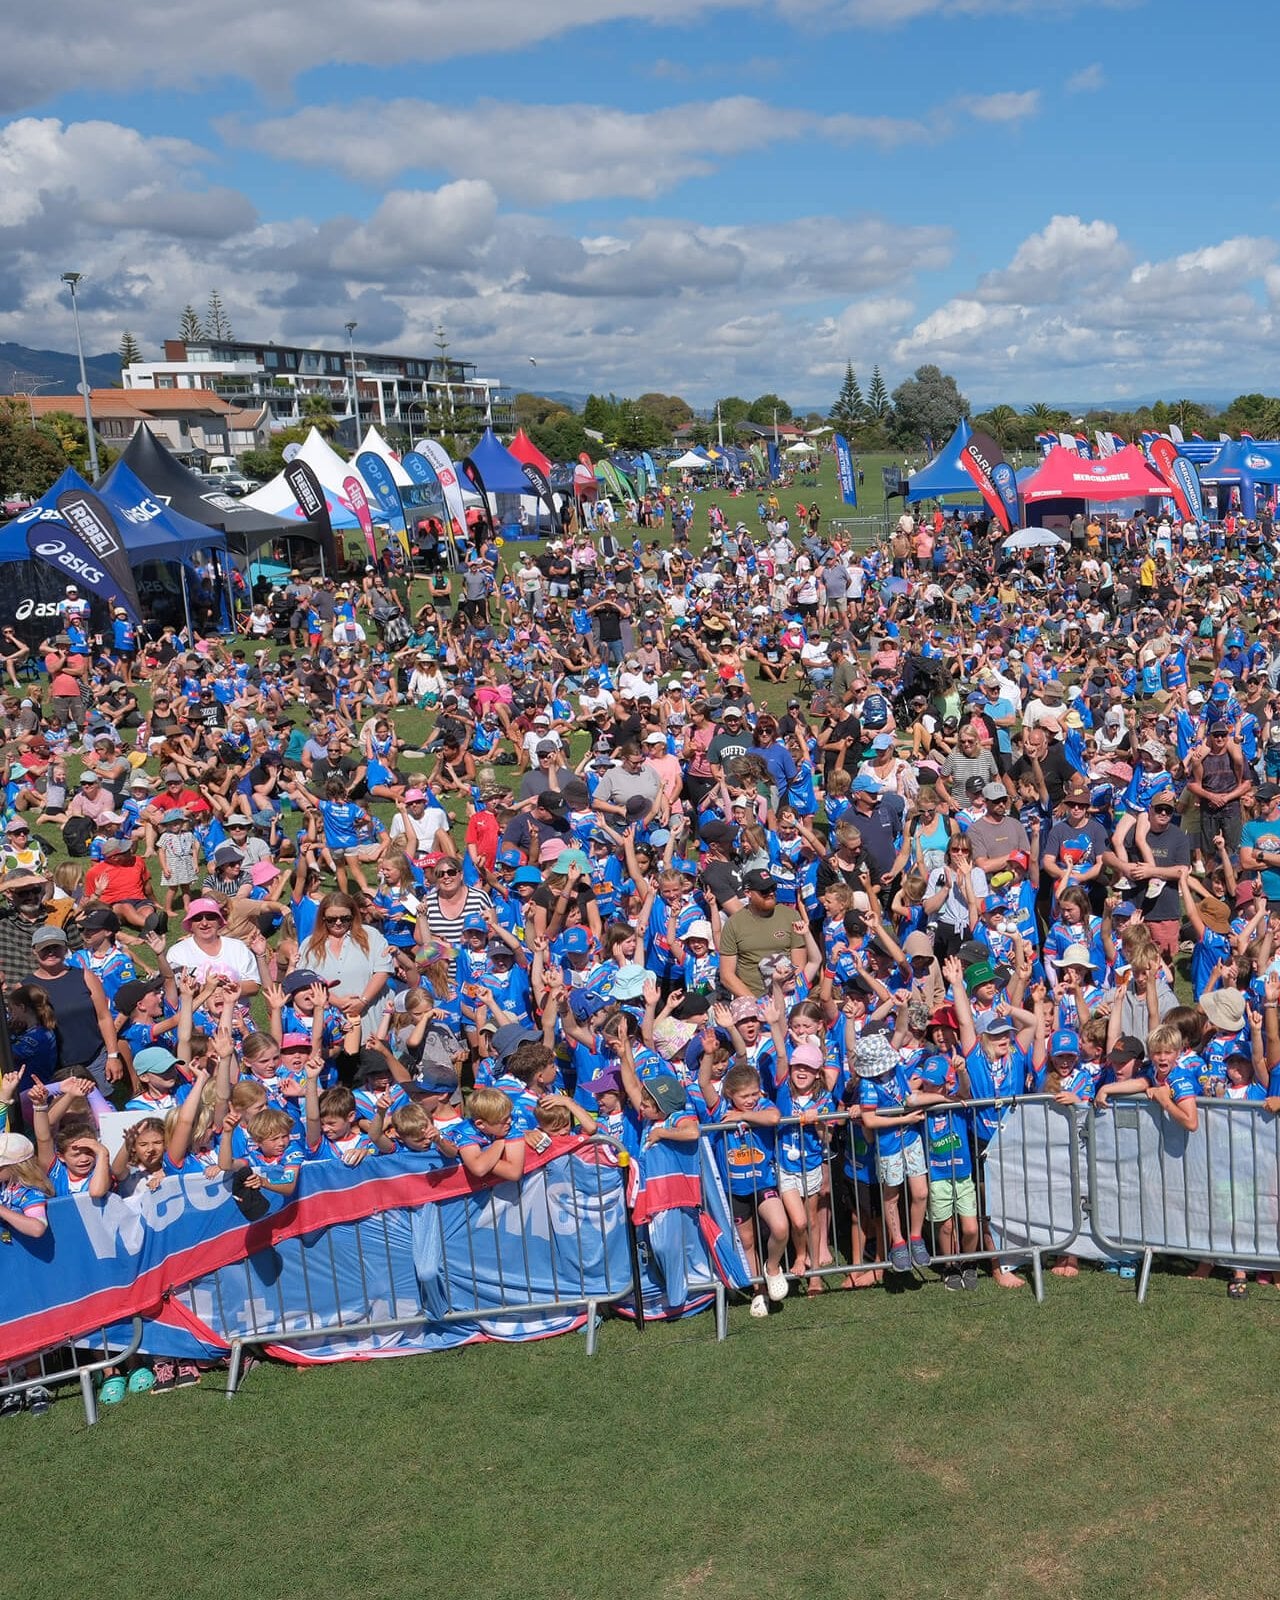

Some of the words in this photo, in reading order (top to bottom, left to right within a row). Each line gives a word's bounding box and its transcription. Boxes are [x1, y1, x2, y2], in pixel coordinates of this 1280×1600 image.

[364, 457, 383, 480] TOP
[409, 457, 427, 480] TOP
[1072, 472, 1131, 483] MERCHANDISE
[294, 473, 317, 511] REBEL
[1179, 461, 1200, 511] MERCHANDISE
[70, 506, 111, 553] REBEL
[57, 551, 105, 584] asics
[34, 602, 61, 617] asi
